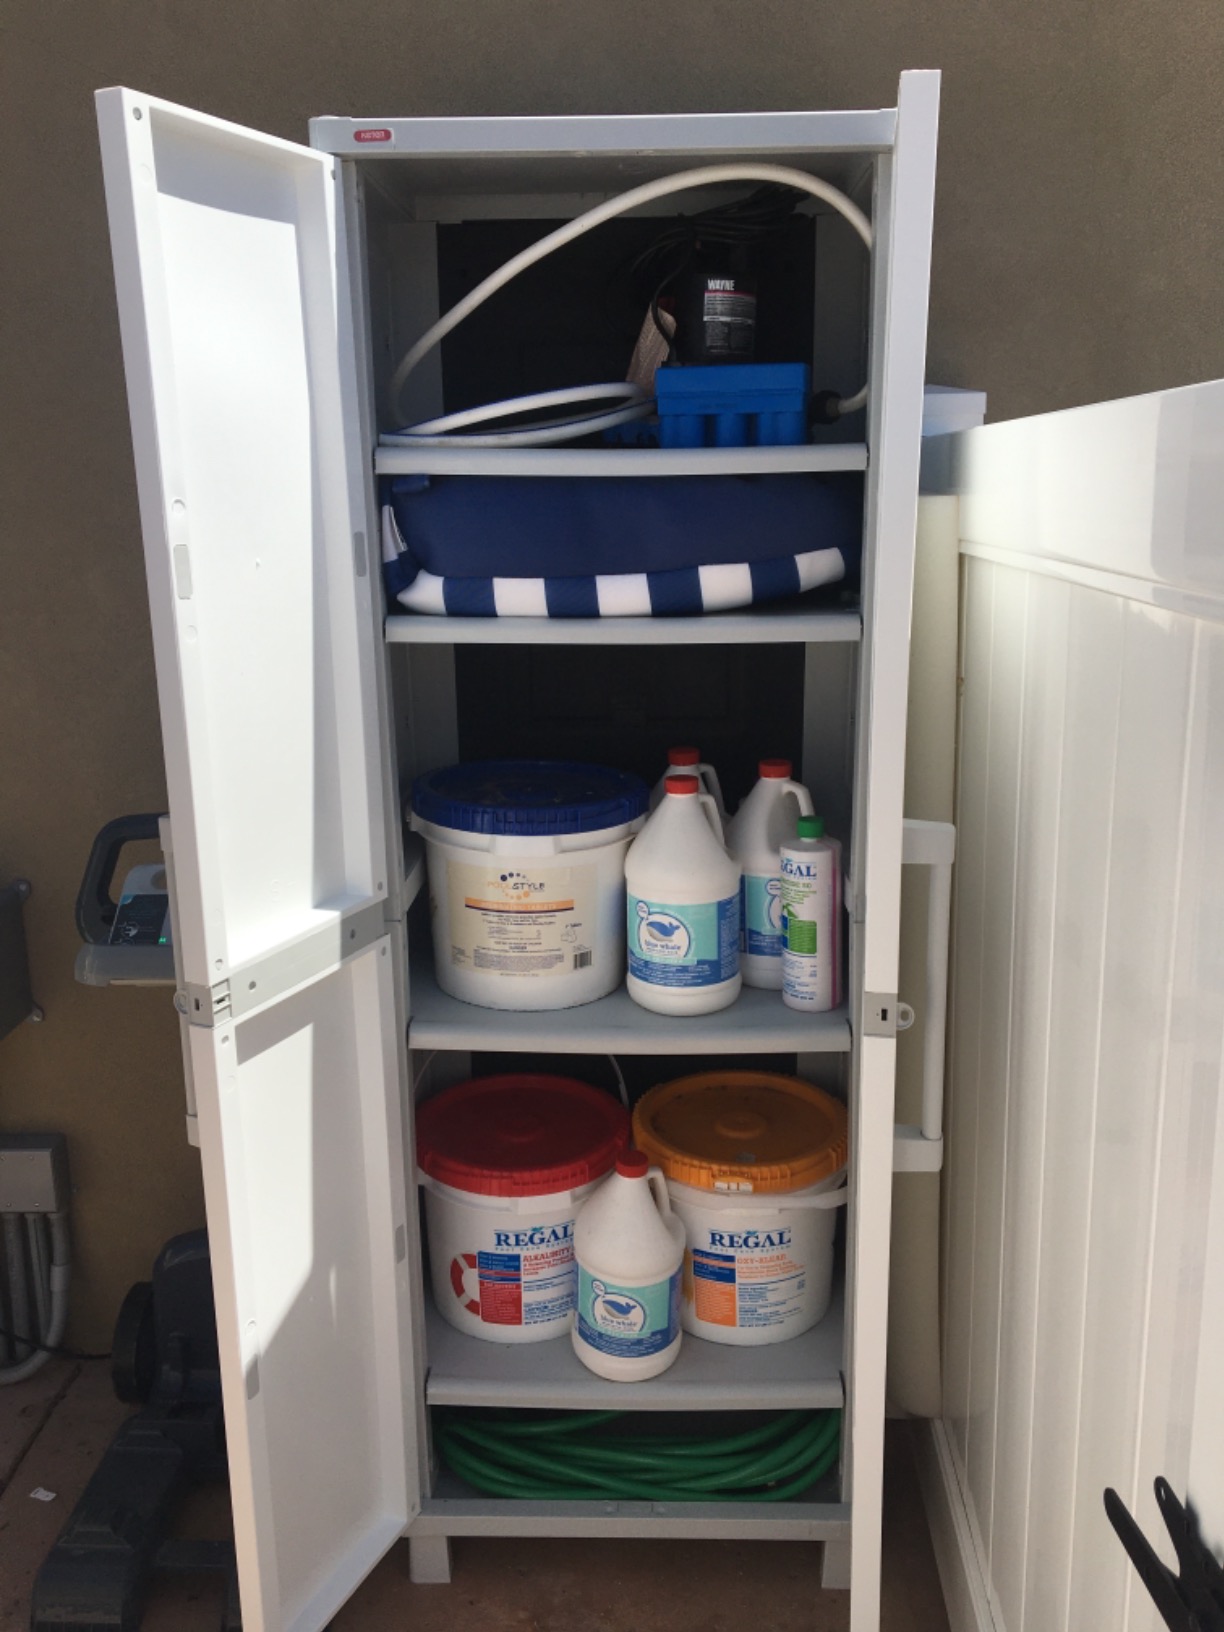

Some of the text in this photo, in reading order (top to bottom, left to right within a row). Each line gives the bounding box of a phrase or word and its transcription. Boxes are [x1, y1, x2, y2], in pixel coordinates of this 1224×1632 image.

[707, 278, 735, 291] WAYNE
[512, 882, 545, 890] STYLE
[494, 1224, 574, 1247] REGAL
[709, 1230, 791, 1248] REGAL
